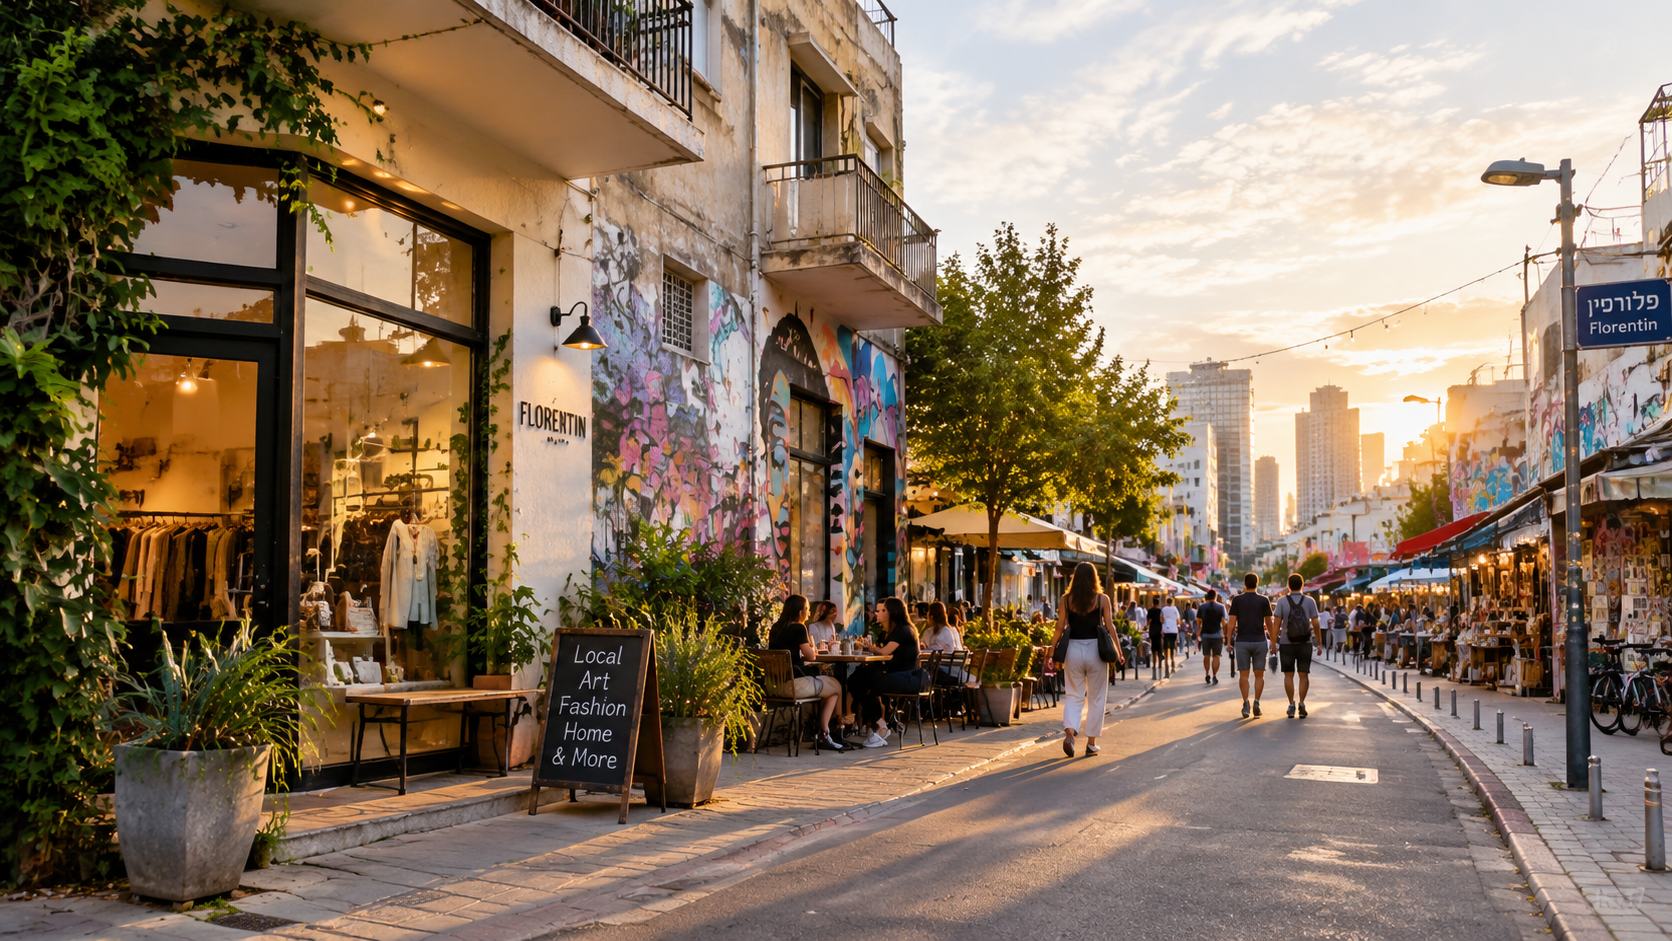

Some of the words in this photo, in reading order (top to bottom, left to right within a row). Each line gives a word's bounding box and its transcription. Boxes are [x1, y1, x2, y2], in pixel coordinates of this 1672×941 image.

[1590, 318, 1658, 335] Florentin
[520, 401, 586, 438] FLORENTIN
[574, 644, 623, 665] Local
[578, 670, 611, 691] Art
[558, 695, 626, 717] Fashion
[563, 721, 613, 743] Home
[552, 746, 566, 766] &
[571, 747, 617, 770] More
